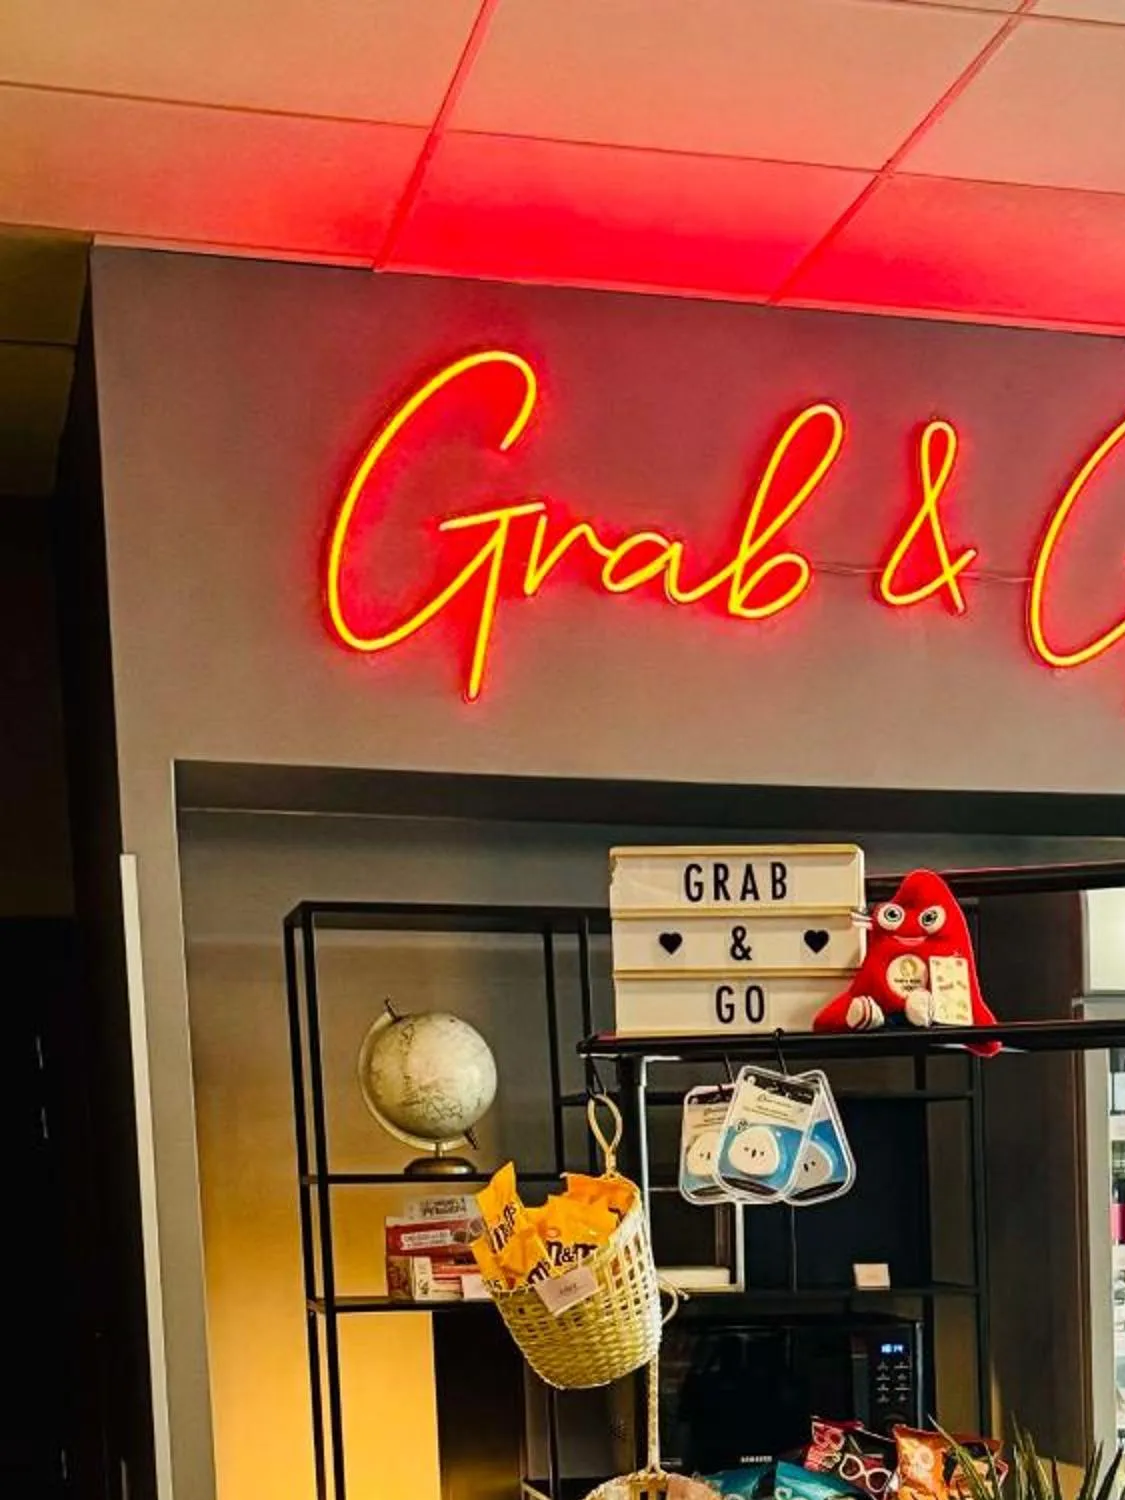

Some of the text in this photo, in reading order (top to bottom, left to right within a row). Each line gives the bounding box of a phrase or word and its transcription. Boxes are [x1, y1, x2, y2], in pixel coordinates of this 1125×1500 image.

[327, 350, 844, 701] Grab
[880, 420, 977, 614] &
[684, 862, 788, 902] GRAB
[729, 926, 752, 961] &
[715, 985, 765, 1024] GO
